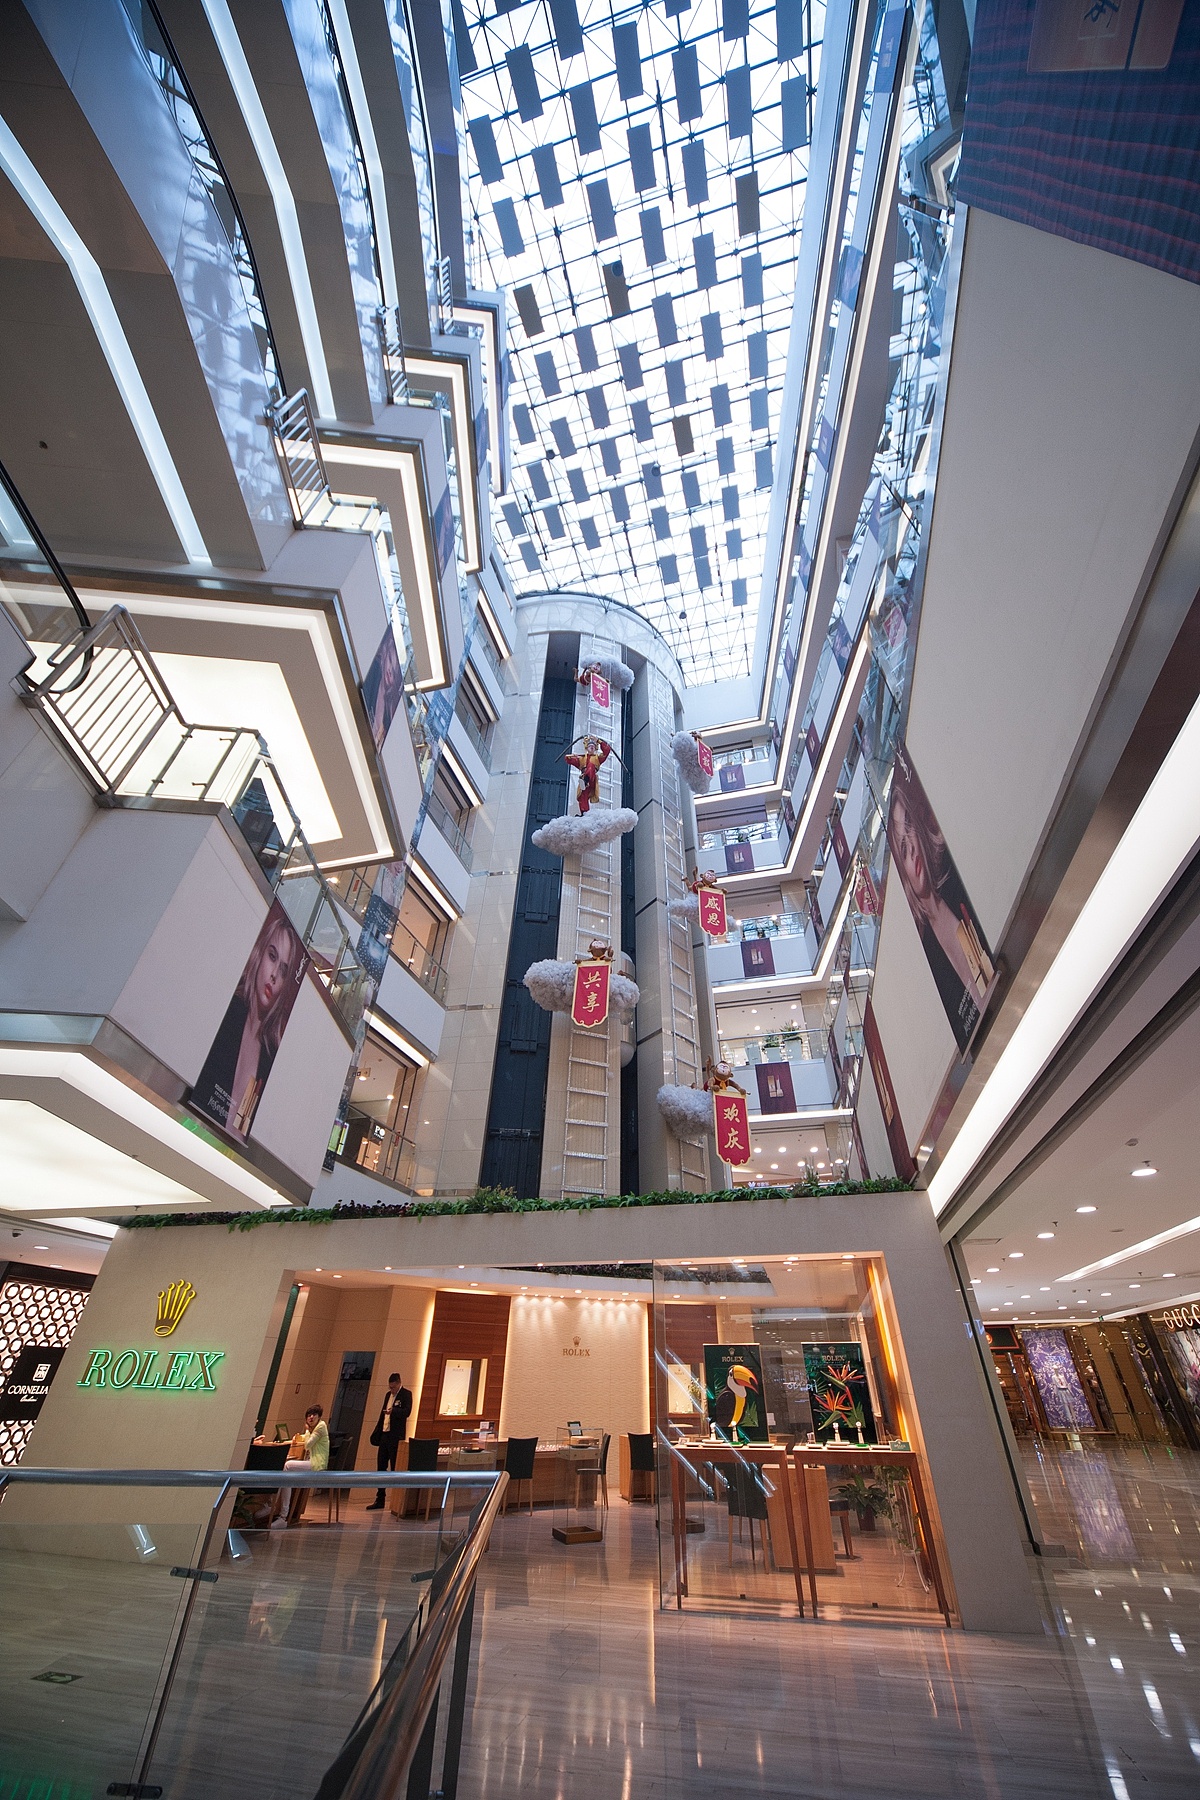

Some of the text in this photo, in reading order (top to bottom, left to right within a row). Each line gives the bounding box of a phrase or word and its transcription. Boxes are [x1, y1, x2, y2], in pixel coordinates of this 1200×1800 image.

[705, 896, 721, 926] 感恩
[582, 971, 602, 1013] 共享
[723, 1103, 745, 1150] 欢庆
[562, 1348, 591, 1357] ROLEX
[721, 1355, 744, 1363] ROLEX
[821, 1354, 846, 1363] ROLEX
[76, 1349, 225, 1390] ROLEX
[7, 1385, 49, 1395] CORNELIA
